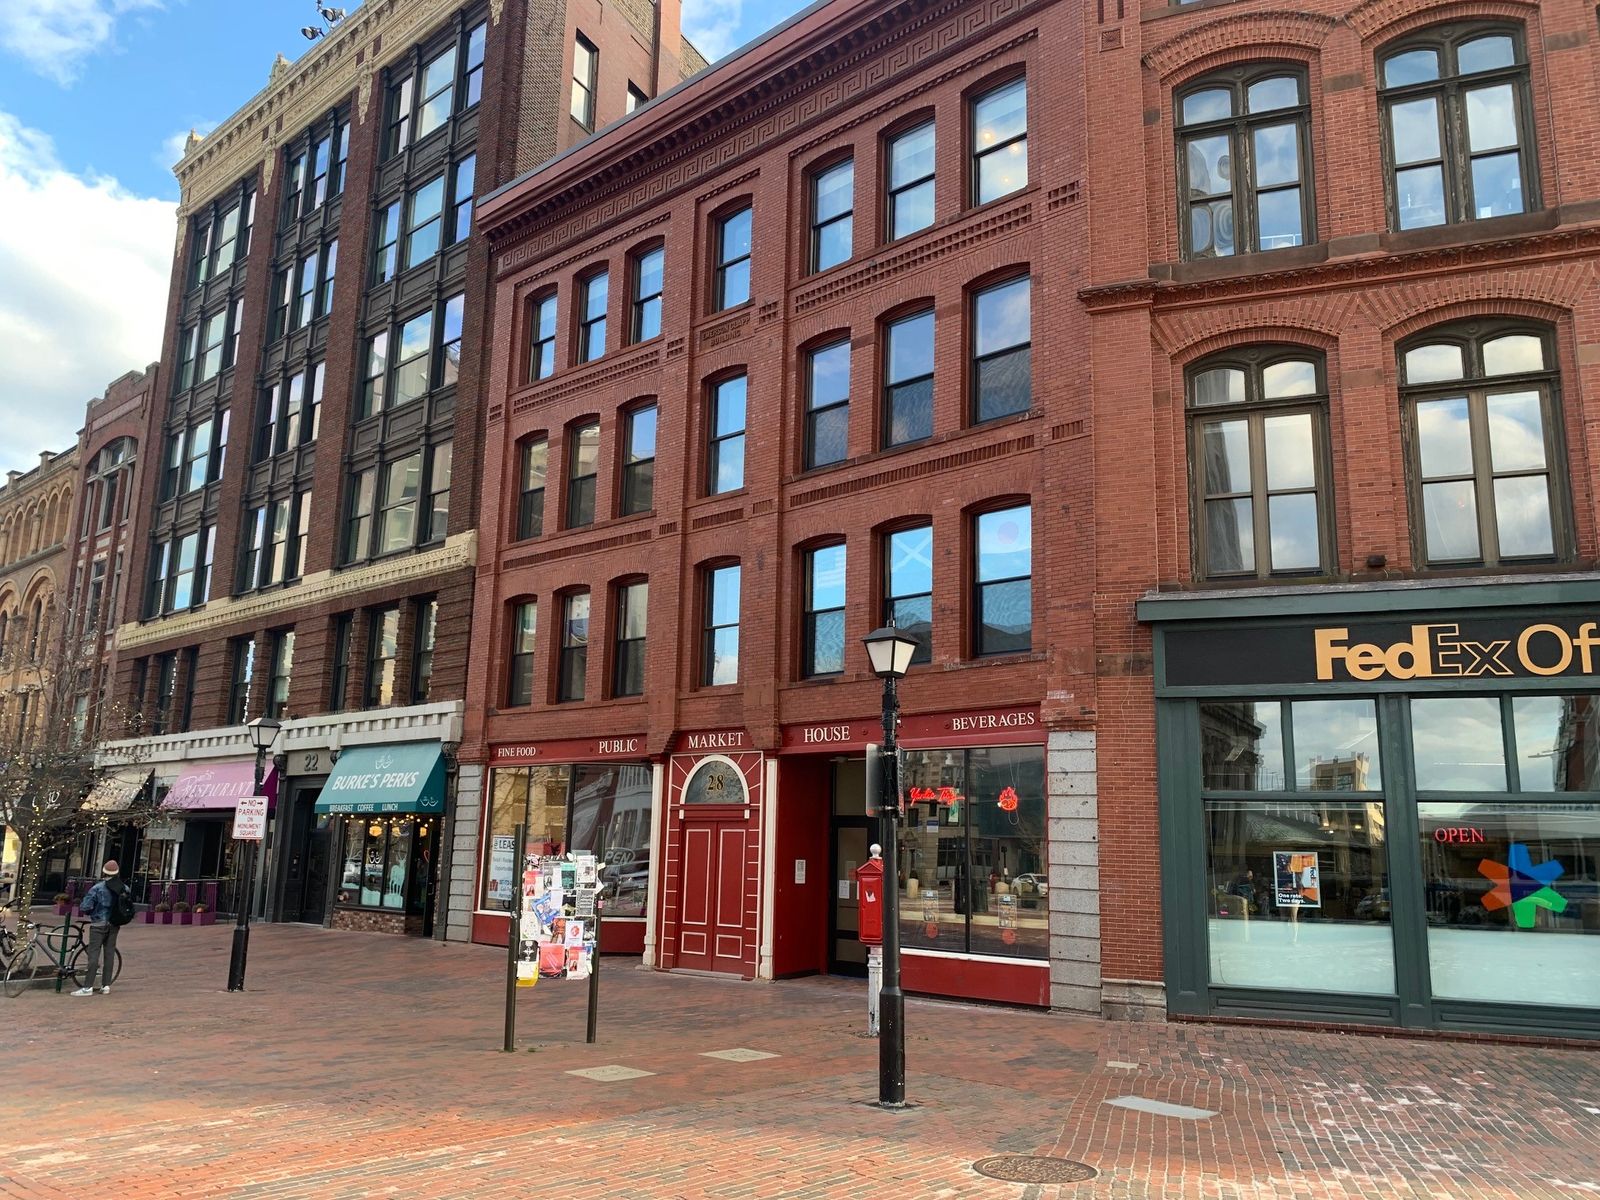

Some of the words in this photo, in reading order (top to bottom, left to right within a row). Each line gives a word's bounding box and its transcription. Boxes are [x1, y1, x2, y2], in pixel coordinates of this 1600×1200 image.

[1314, 624, 1514, 681] FedEx
[952, 712, 1035, 731] BEVERAGES
[688, 732, 744, 749] MARKET
[804, 726, 851, 743] HOUSE
[498, 748, 516, 757] FINE
[517, 746, 536, 757] FOOD
[598, 738, 638, 754] PUBLIC
[304, 753, 319, 772] 22
[332, 774, 379, 791] BURKE'S
[379, 772, 419, 788] PERKS
[707, 774, 725, 791] 28
[238, 808, 264, 816] PARKING
[329, 803, 354, 812] BREAKFAST
[357, 803, 374, 812] COFFEE
[381, 803, 399, 811] LUNCH
[1434, 827, 1485, 843] OPEN
[499, 840, 515, 850] LEAS
[604, 850, 632, 864] PEN
